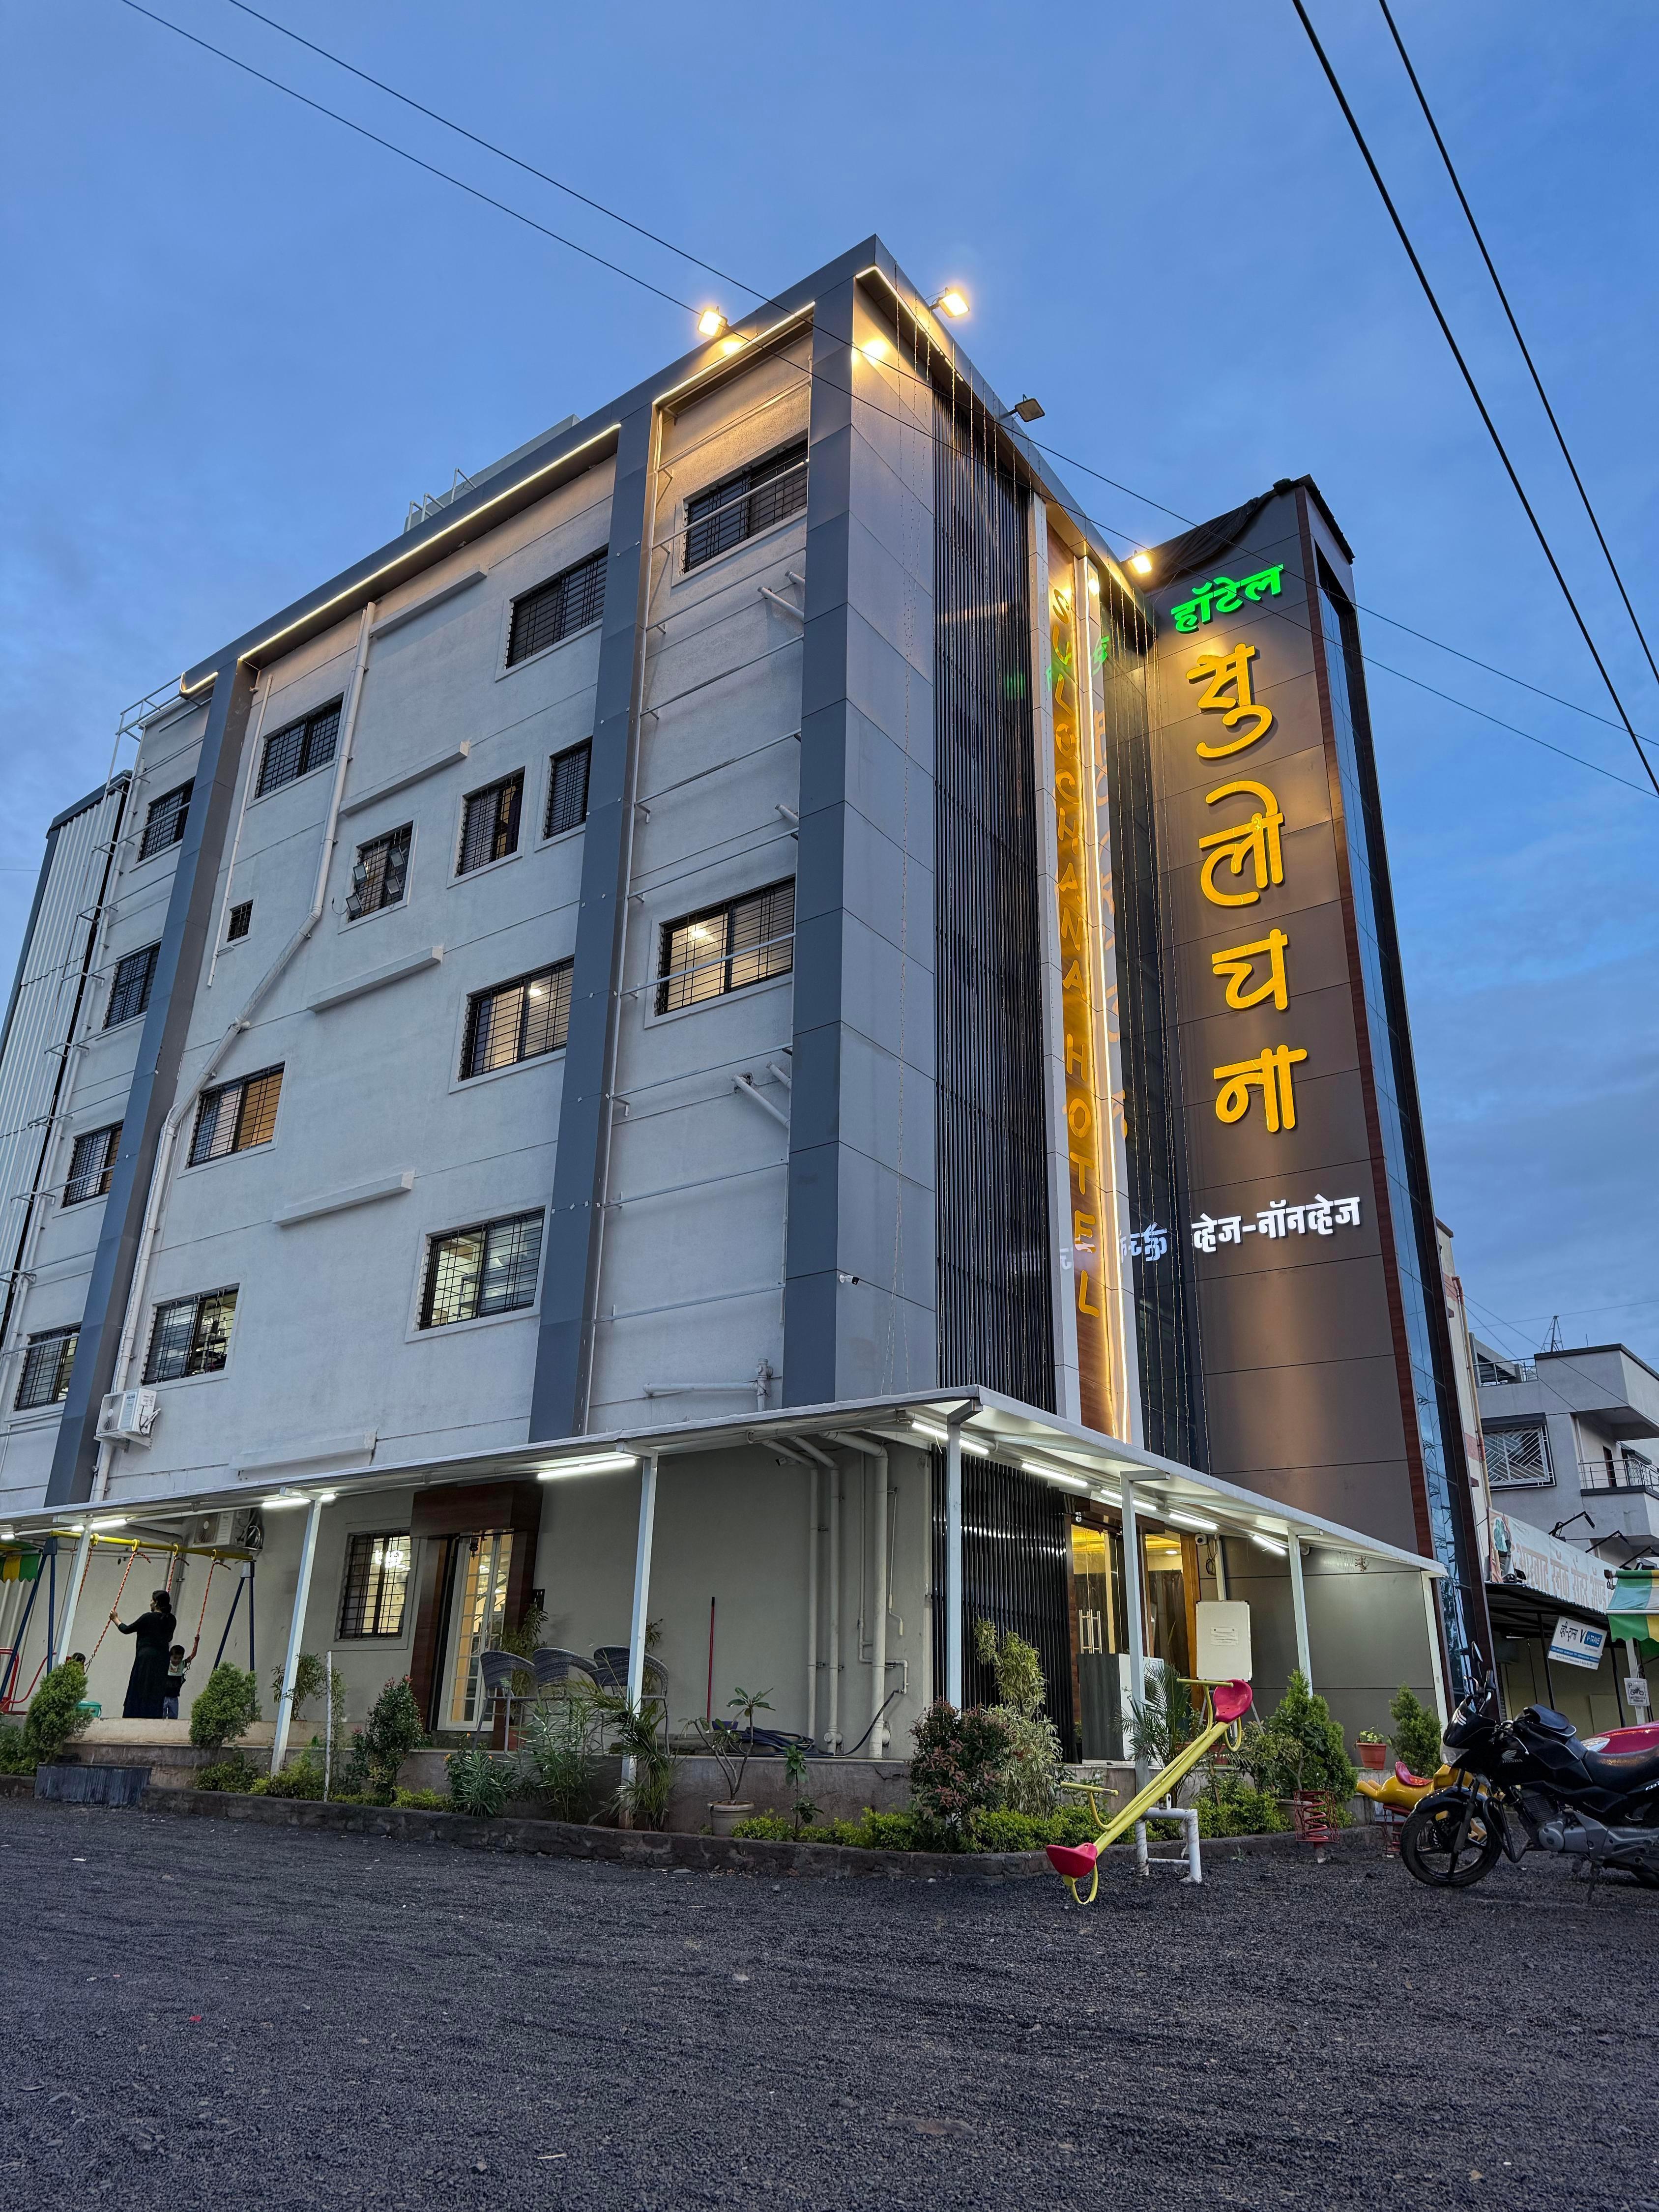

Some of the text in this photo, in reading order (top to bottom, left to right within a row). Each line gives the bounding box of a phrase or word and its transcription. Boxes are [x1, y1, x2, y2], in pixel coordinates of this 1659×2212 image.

[1170, 563, 1284, 633] हॉटेल
[1052, 589, 1100, 1318] SULOCHANA HOTEL
[1185, 642, 1308, 1133] सुलोचना
[1191, 1193, 1361, 1253] व्हेज-नॉनव्हेज
